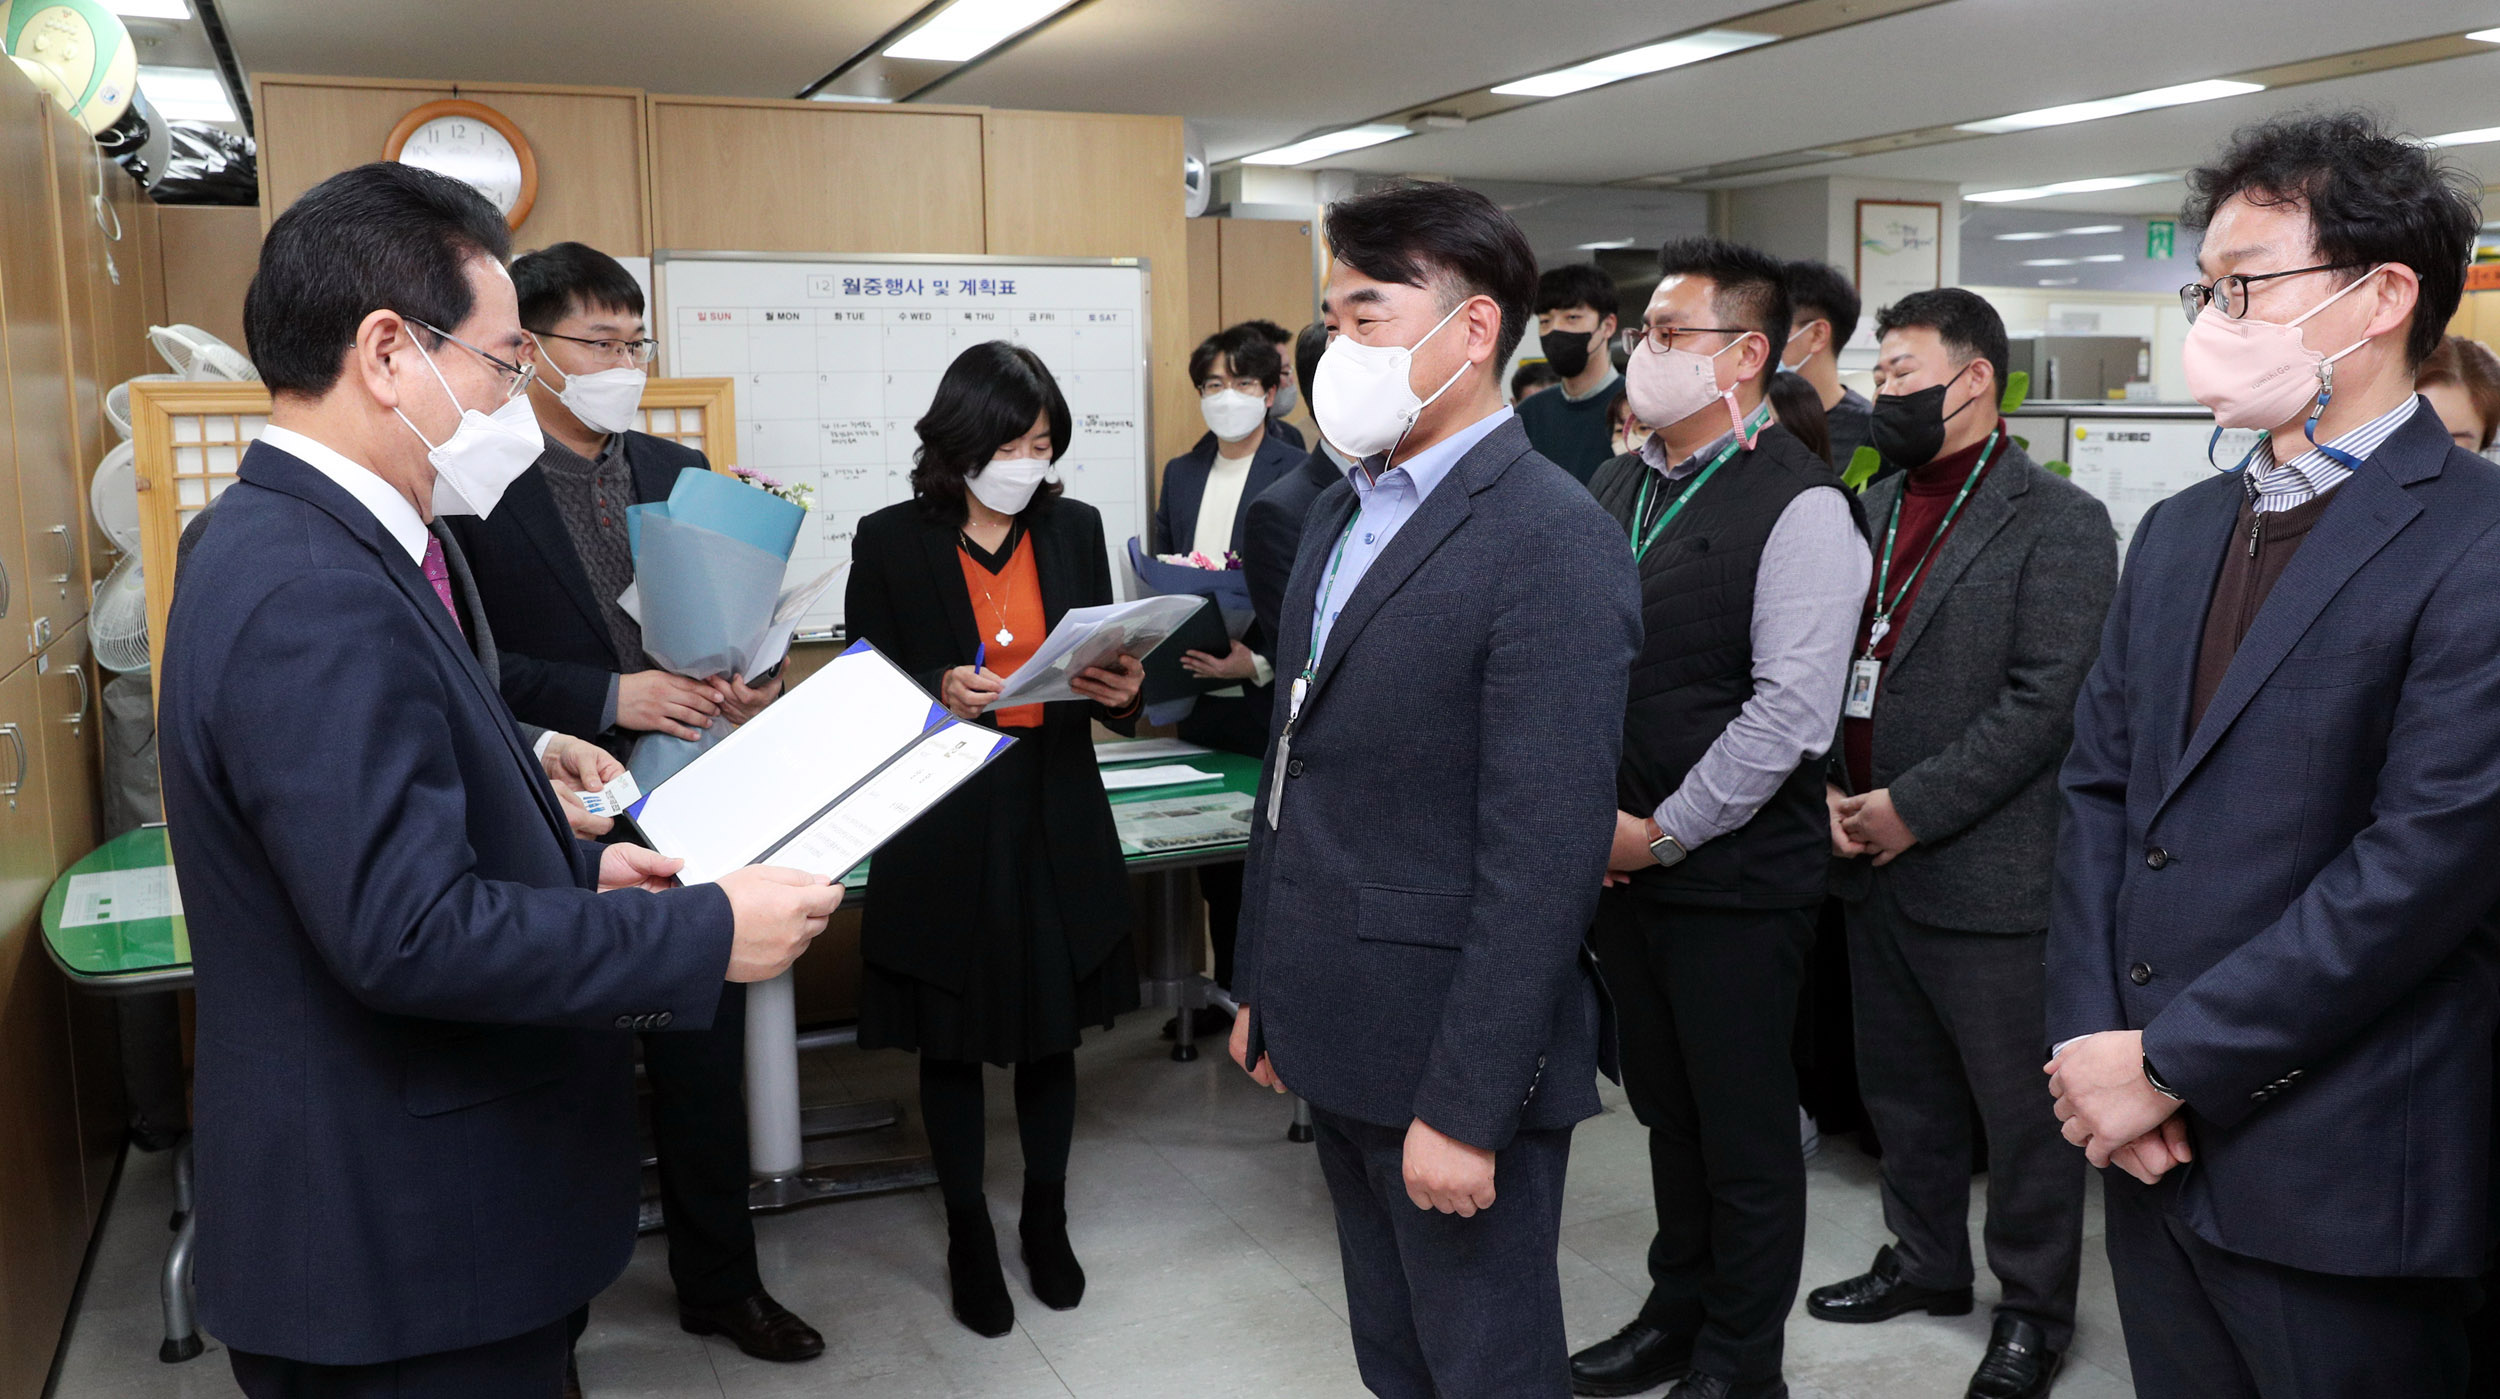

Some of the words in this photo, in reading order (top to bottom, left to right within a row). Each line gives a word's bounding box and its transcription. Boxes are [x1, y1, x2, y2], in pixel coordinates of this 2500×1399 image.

[428, 129, 439, 143] 11
[451, 124, 465, 139] 12
[480, 131, 485, 146] 1
[815, 281, 831, 292] 12
[842, 277, 925, 296] 월중행사
[932, 279, 950, 296] 및
[958, 278, 1018, 296] 계획표
[710, 312, 732, 321] SUN
[777, 312, 800, 321] MON
[846, 312, 865, 321] TUE
[910, 312, 932, 321] WED
[975, 312, 995, 321] THU
[1039, 313, 1055, 321] FRI
[1099, 313, 1117, 322] SAT
